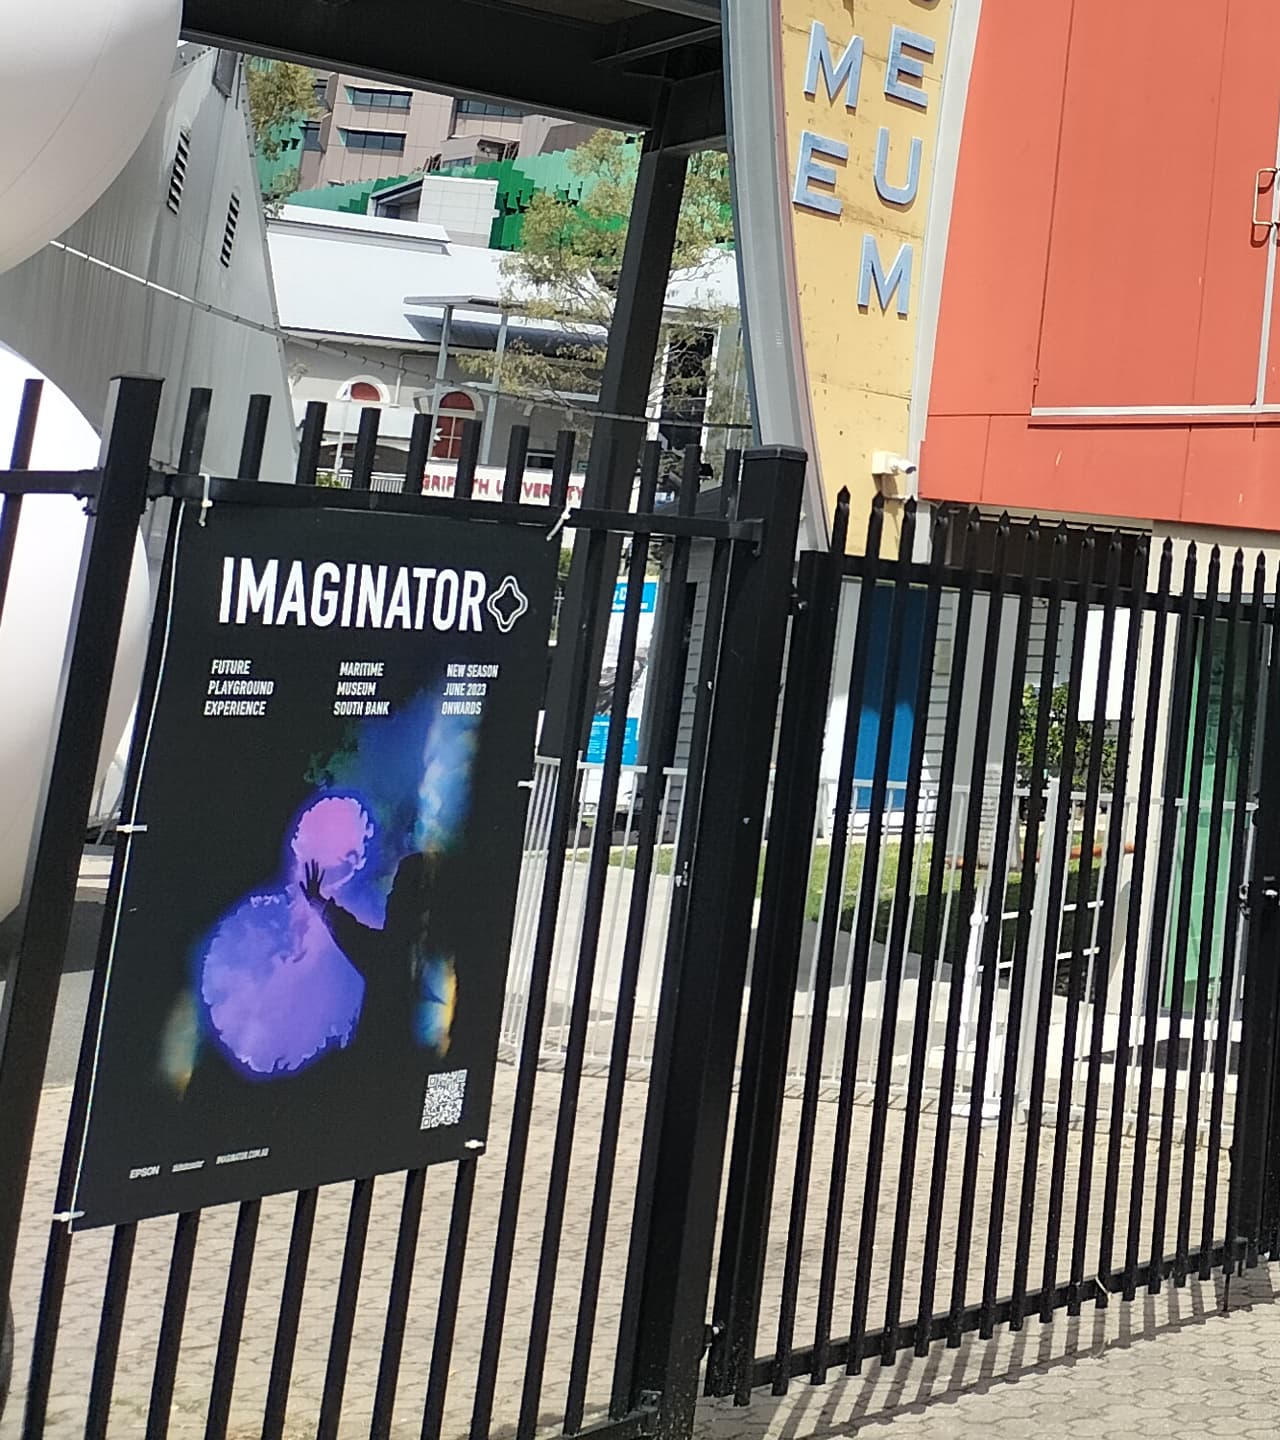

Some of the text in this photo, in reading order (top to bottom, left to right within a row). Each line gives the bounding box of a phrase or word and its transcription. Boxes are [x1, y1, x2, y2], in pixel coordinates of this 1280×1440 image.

[218, 556, 487, 632] IMAGINATOR
[211, 659, 252, 675] FUTURE
[339, 661, 385, 677] MARITIME
[446, 663, 499, 678] NEW SEASON
[207, 680, 274, 695] PLAYGROUND
[336, 681, 377, 696] MUSEUM
[443, 682, 487, 696] JUNE 2023
[203, 700, 267, 716] EXPERIENCE
[333, 701, 390, 716] SOUTH BANK
[441, 701, 483, 715] ONWARDS
[129, 1165, 160, 1179] EPSON
